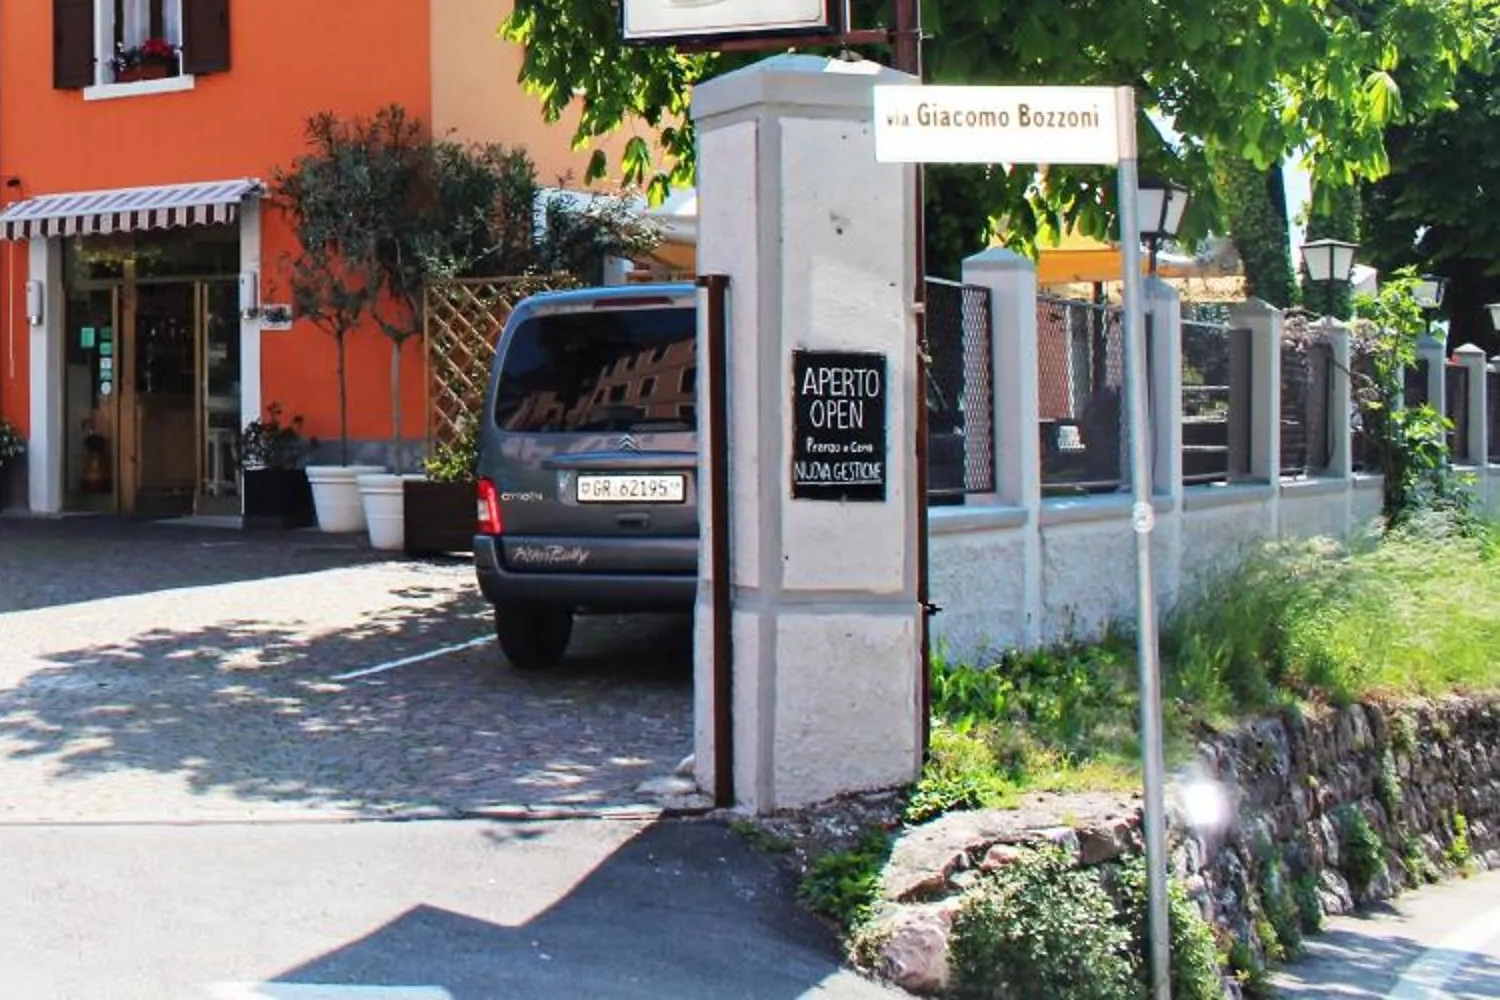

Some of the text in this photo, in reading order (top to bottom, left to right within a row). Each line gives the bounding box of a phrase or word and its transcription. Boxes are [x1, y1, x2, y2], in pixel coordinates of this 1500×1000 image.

[886, 103, 1100, 128] via Giacomo Bozzoni
[801, 366, 880, 398] APERTO
[809, 399, 864, 430] OPEN
[593, 479, 611, 497] GR
